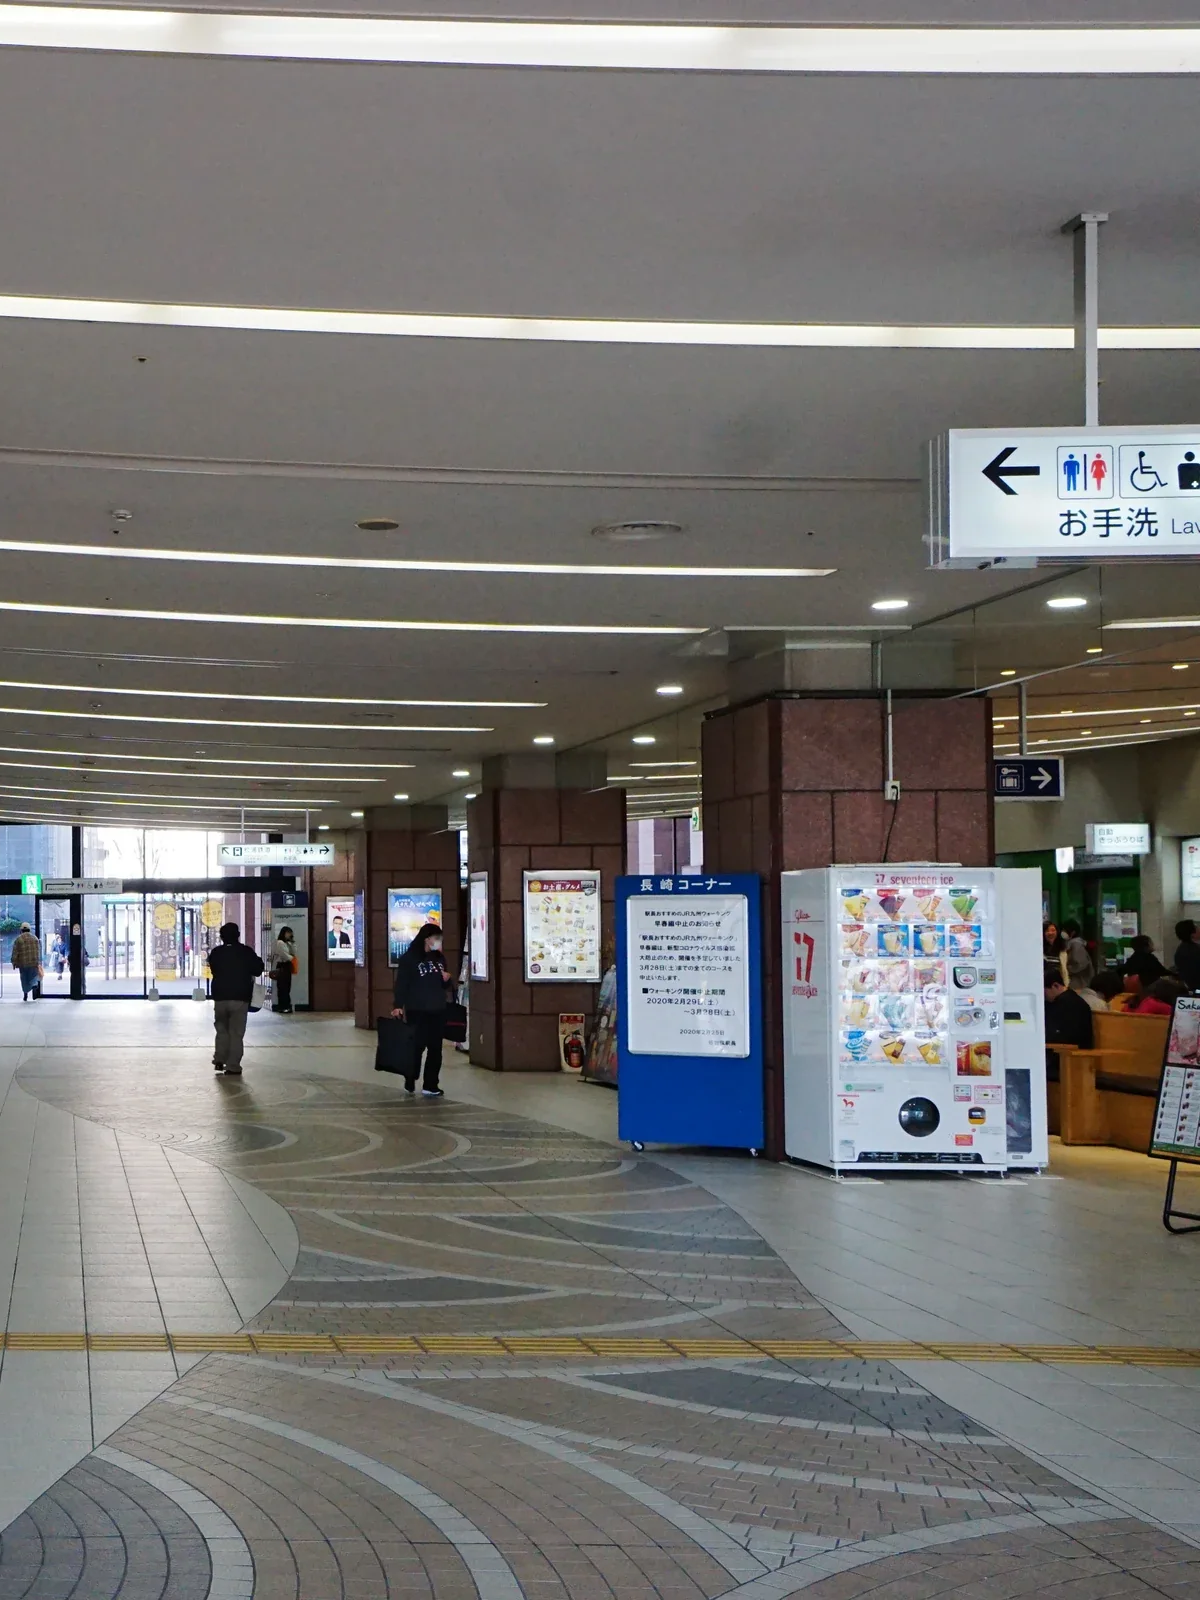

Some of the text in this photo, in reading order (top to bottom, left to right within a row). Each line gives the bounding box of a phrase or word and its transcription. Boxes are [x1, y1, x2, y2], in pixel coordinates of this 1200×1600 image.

[1059, 507, 1159, 537] お手洗
[890, 874, 937, 885] seventeen
[940, 873, 954, 885] ice
